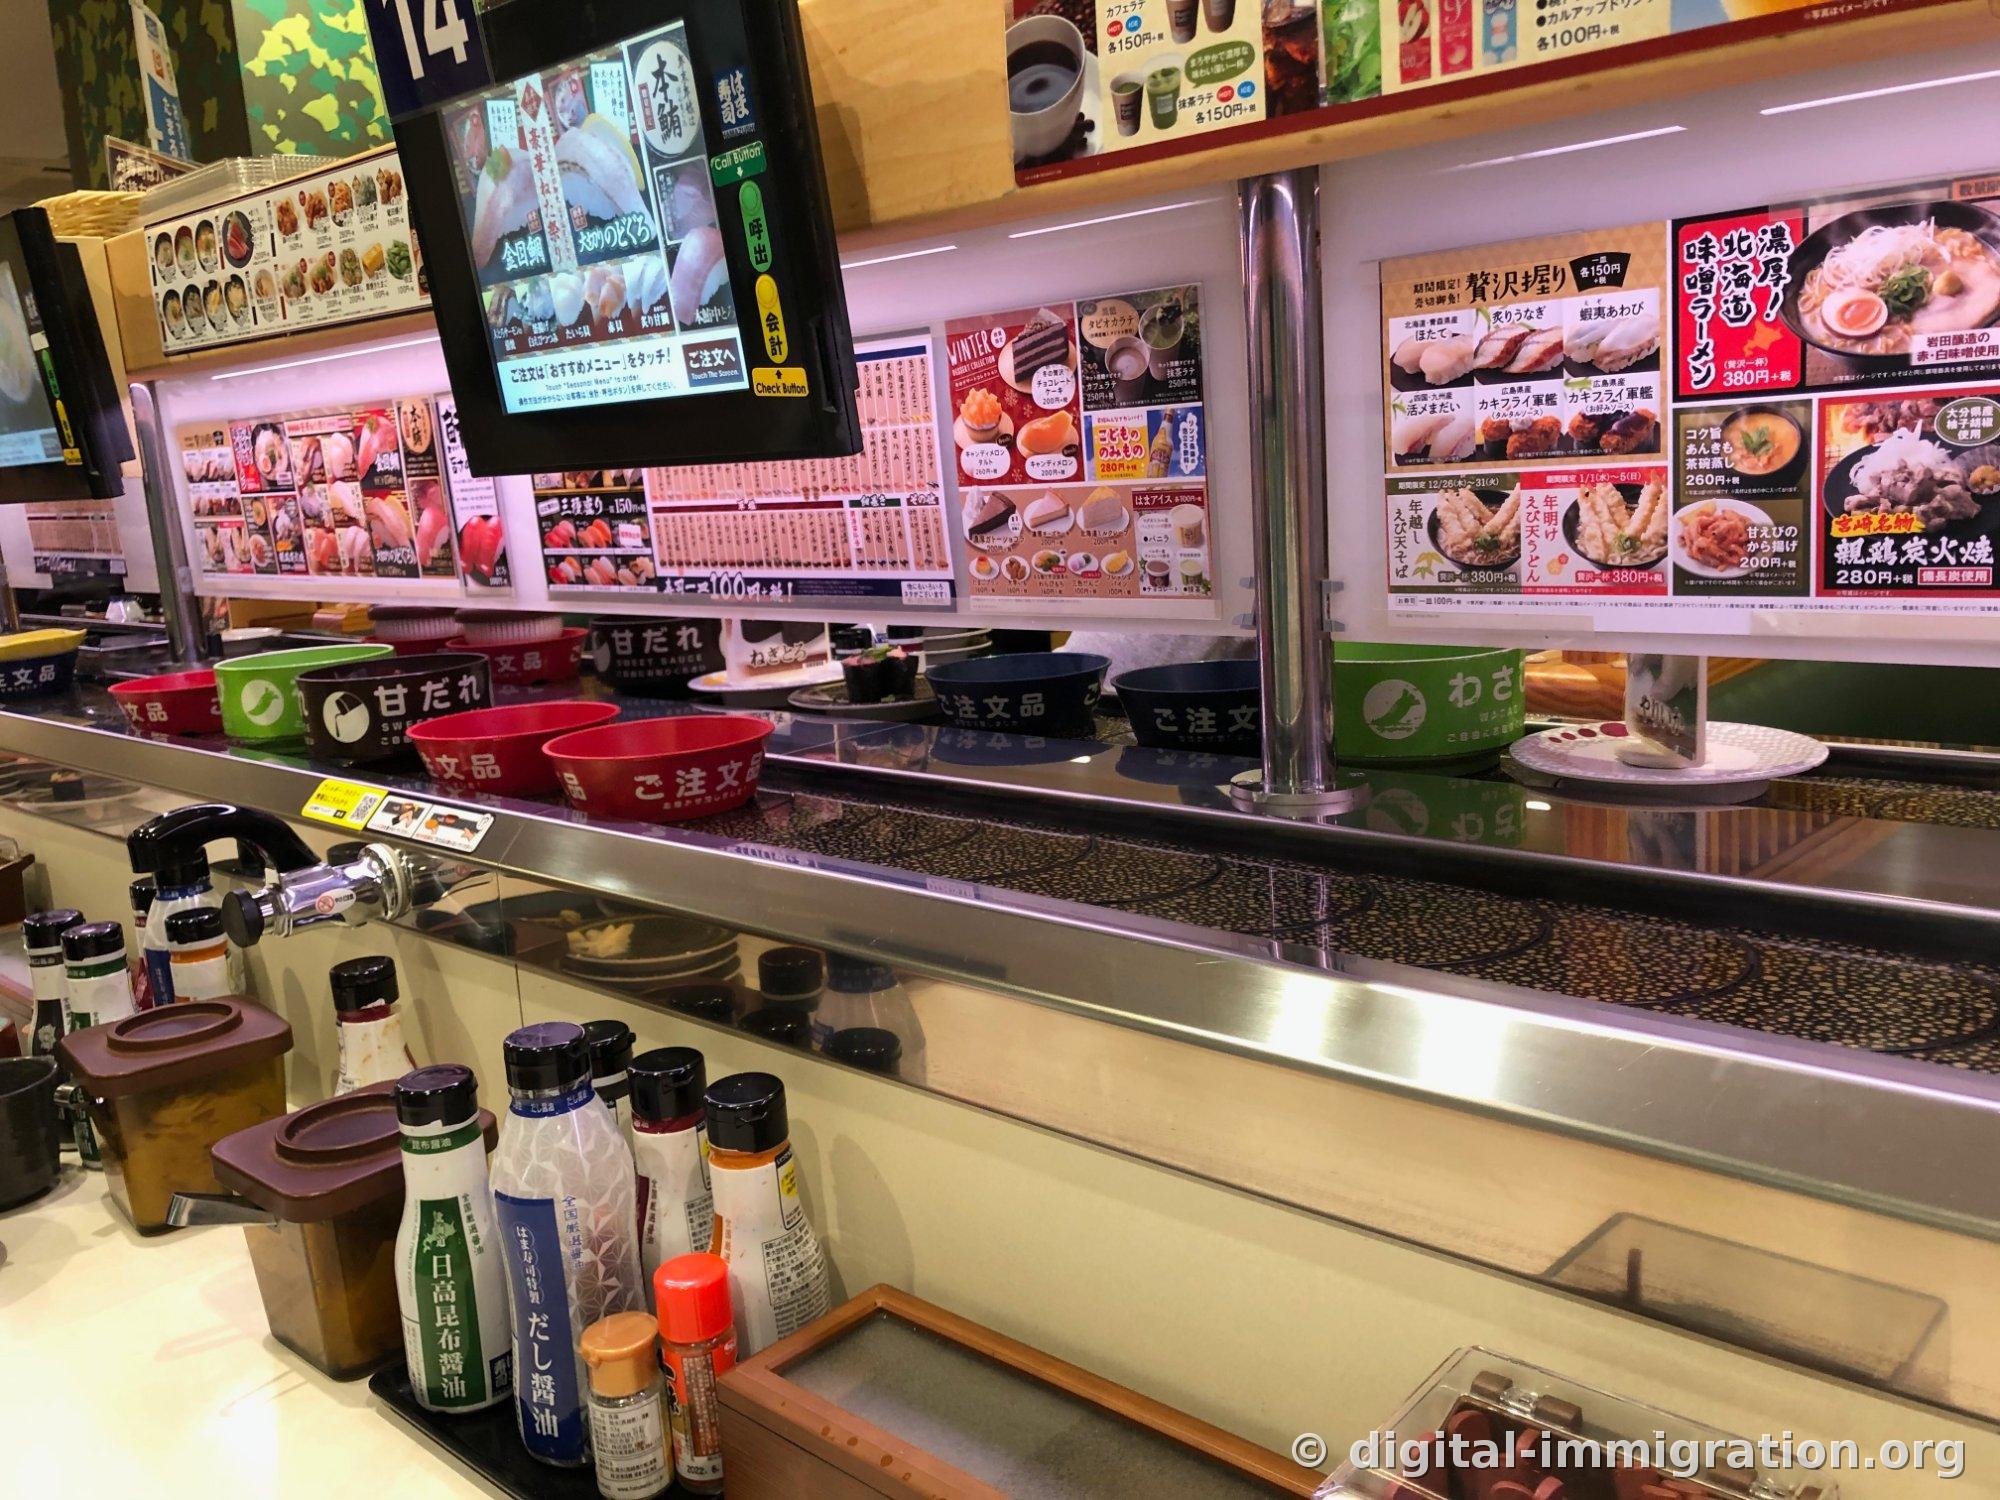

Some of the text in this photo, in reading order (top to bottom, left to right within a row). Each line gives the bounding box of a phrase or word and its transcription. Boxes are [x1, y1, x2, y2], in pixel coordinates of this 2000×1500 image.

[381, 0, 469, 80] 14
[651, 53, 683, 144] 本鮪
[1177, 92, 1214, 109] 抹茶ラテ
[714, 146, 762, 171] Call Button
[750, 217, 769, 266] 呼出
[1580, 263, 1621, 278] 各150円
[1721, 229, 1753, 325] 北海道
[1465, 263, 1566, 304] 贅沢握り
[1492, 304, 1546, 325] 炙りうなぎ
[1579, 301, 1645, 322] 蝦夷あわび
[1685, 236, 1717, 388] 味噌ラーメン
[1089, 316, 1134, 330] タピオカラテ
[765, 312, 783, 357] 会計
[1415, 328, 1448, 341] ほたて
[1927, 331, 1990, 348] 岩田醸造の
[946, 329, 992, 366] WINTER
[1917, 345, 2000, 362] 赤・白味噌使用
[689, 348, 736, 369] ご注文へ
[691, 372, 708, 381] Touch
[1037, 379, 1071, 388] チョコレート
[1592, 377, 1626, 388] 広島県産
[1722, 368, 1792, 387] 380円+税
[756, 382, 807, 395] Check Button
[1086, 381, 1117, 391] カフェラテ
[1501, 385, 1532, 396] 広島県産
[1479, 392, 1559, 411] カキフライ軍艦
[1568, 386, 1654, 404] カキフライ軍艦
[1947, 405, 1994, 419] 大分県産
[1098, 426, 1139, 442] こどもの
[1686, 427, 1722, 440] コク旨
[1958, 429, 1981, 440] 使用
[1098, 443, 1143, 459] のみもの
[1686, 441, 1733, 455] あんきも
[1685, 456, 1735, 470] 茶碗蒸し
[1686, 473, 1740, 486] 260円+税
[1135, 494, 1172, 506] はまアイス
[1409, 500, 1423, 544] 年越し
[1543, 494, 1559, 542] 年明け
[1836, 514, 1916, 535] 宮崎名物
[1525, 495, 1540, 583] えび天うどん
[1746, 526, 1798, 538] 甘えびの
[1393, 509, 1408, 579] えび天そば
[1746, 540, 1798, 553] から揚げ
[1835, 535, 1994, 567] 親鶏炭火焼
[1739, 557, 1797, 568] 200円+税
[1470, 570, 1518, 583] 380円+税
[1612, 569, 1664, 583] 380円+税
[1836, 569, 1914, 585] 280円+税
[1921, 570, 1988, 583] 備長炭使用
[611, 625, 703, 655] 甘だれ
[749, 640, 808, 667] ねぎとろ
[1448, 661, 1525, 708] わさ
[373, 674, 481, 717] 甘だれ
[411, 1136, 452, 1150] 昆布醤油
[431, 1253, 467, 1400] 日高昆布醤油
[527, 1311, 560, 1439] だし醤油
